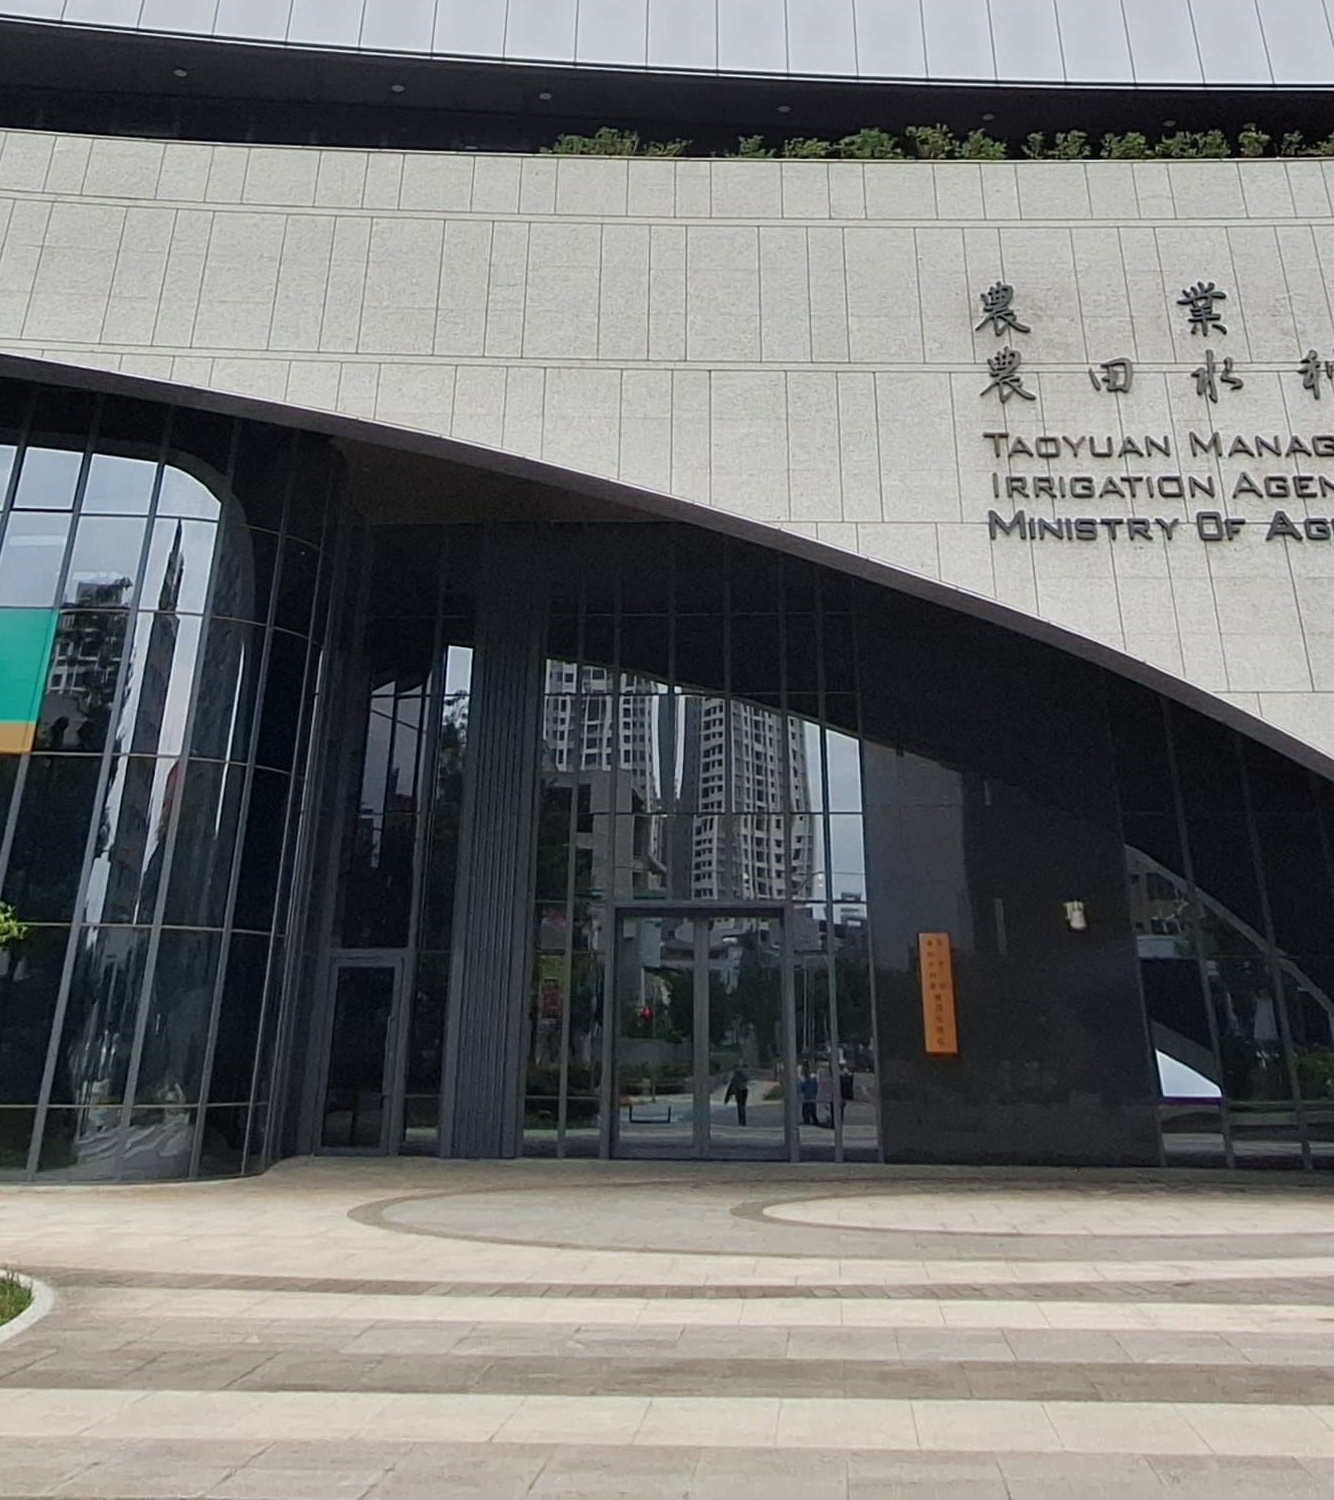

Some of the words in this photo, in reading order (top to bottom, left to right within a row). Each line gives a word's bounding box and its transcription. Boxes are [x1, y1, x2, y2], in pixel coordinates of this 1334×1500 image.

[983, 431, 1171, 459] TAOYUAN
[992, 472, 1215, 500] IRRIGATION
[987, 510, 1179, 542] MINISTRY
